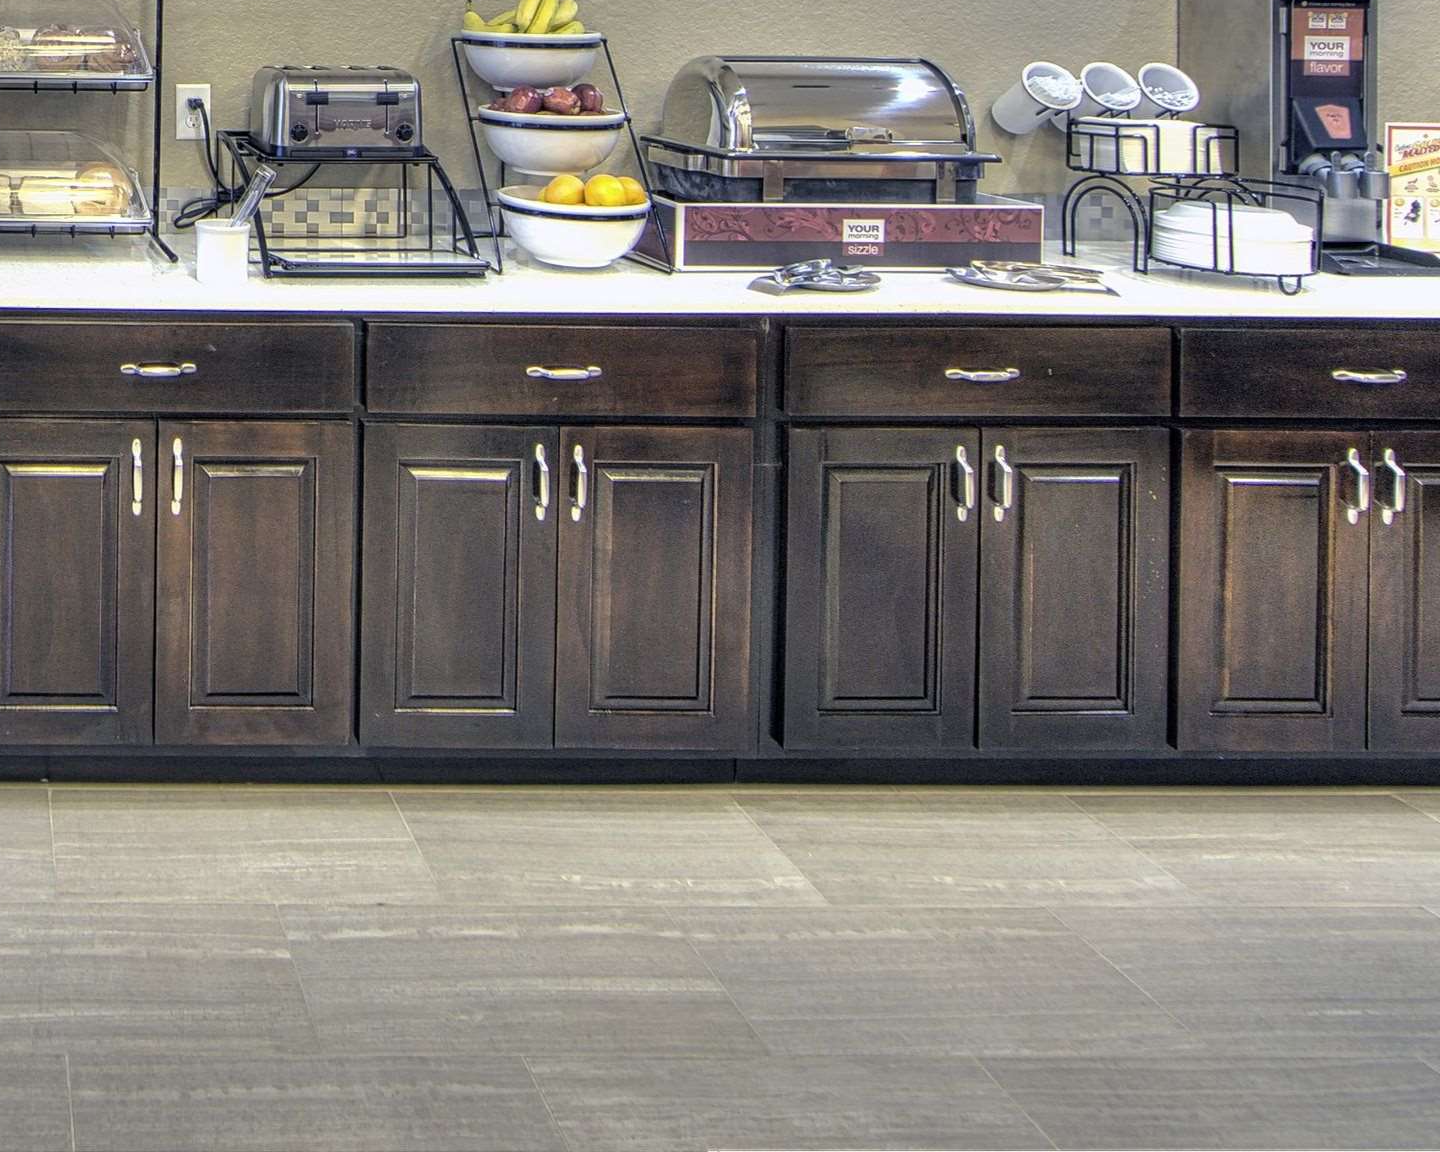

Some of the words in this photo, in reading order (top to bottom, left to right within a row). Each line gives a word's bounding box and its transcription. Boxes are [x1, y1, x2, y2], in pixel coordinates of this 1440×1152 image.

[1310, 41, 1345, 51] YOUR
[1310, 61, 1344, 73] flavor
[848, 224, 880, 233] YOUR
[847, 243, 879, 255] sizzle
